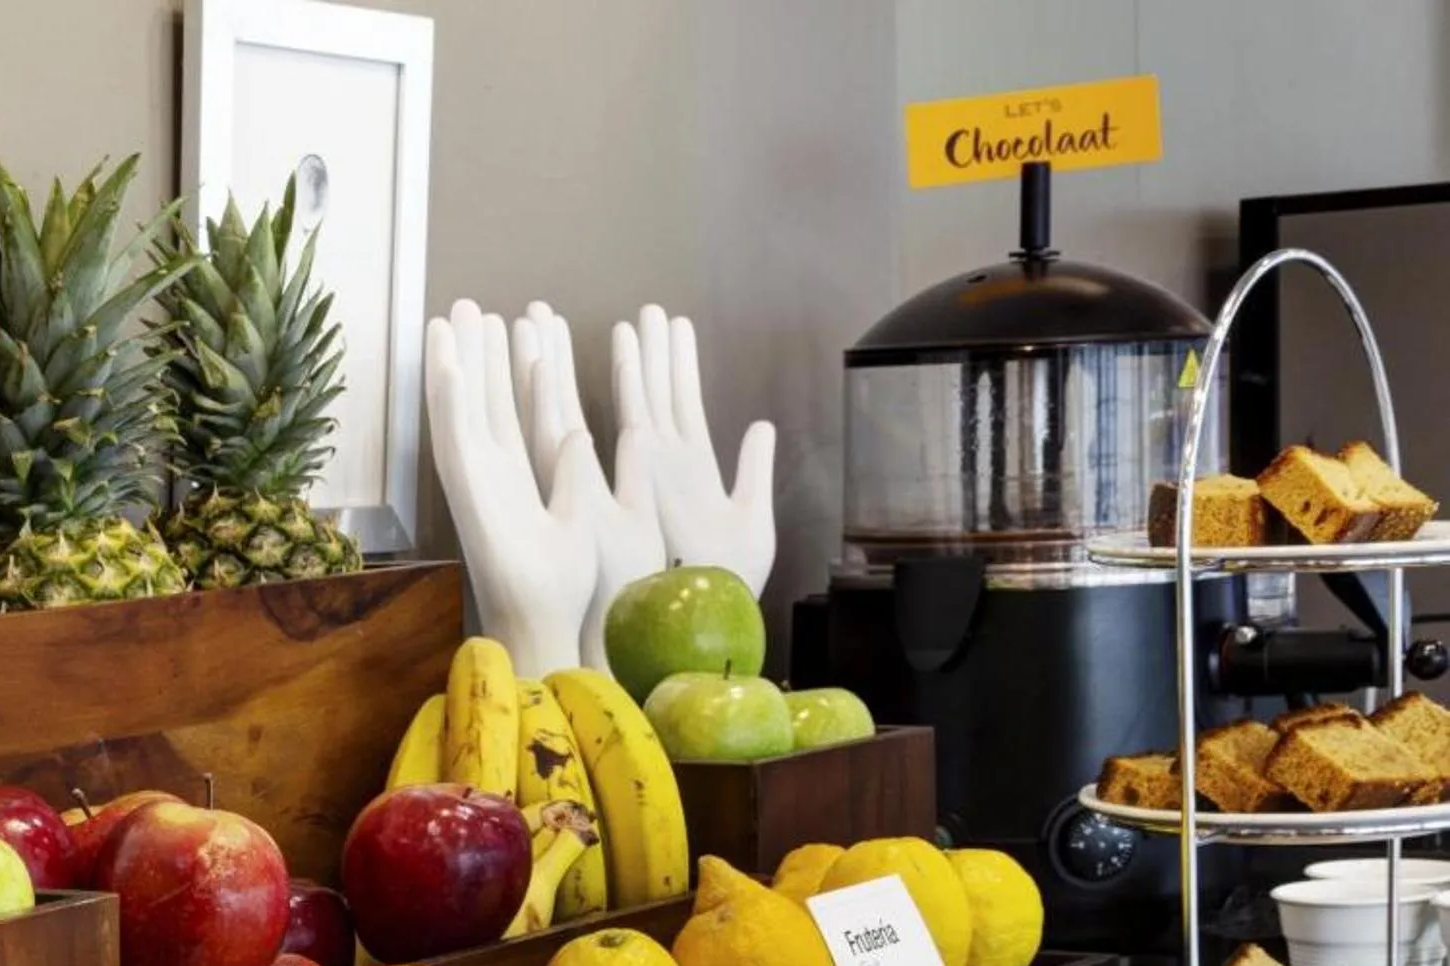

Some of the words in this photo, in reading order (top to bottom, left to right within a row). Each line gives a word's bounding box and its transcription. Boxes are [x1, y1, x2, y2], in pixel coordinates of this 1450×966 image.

[1005, 98, 1062, 118] LET'S
[945, 112, 1121, 168] Chocolaat
[844, 917, 900, 955] Frutería
